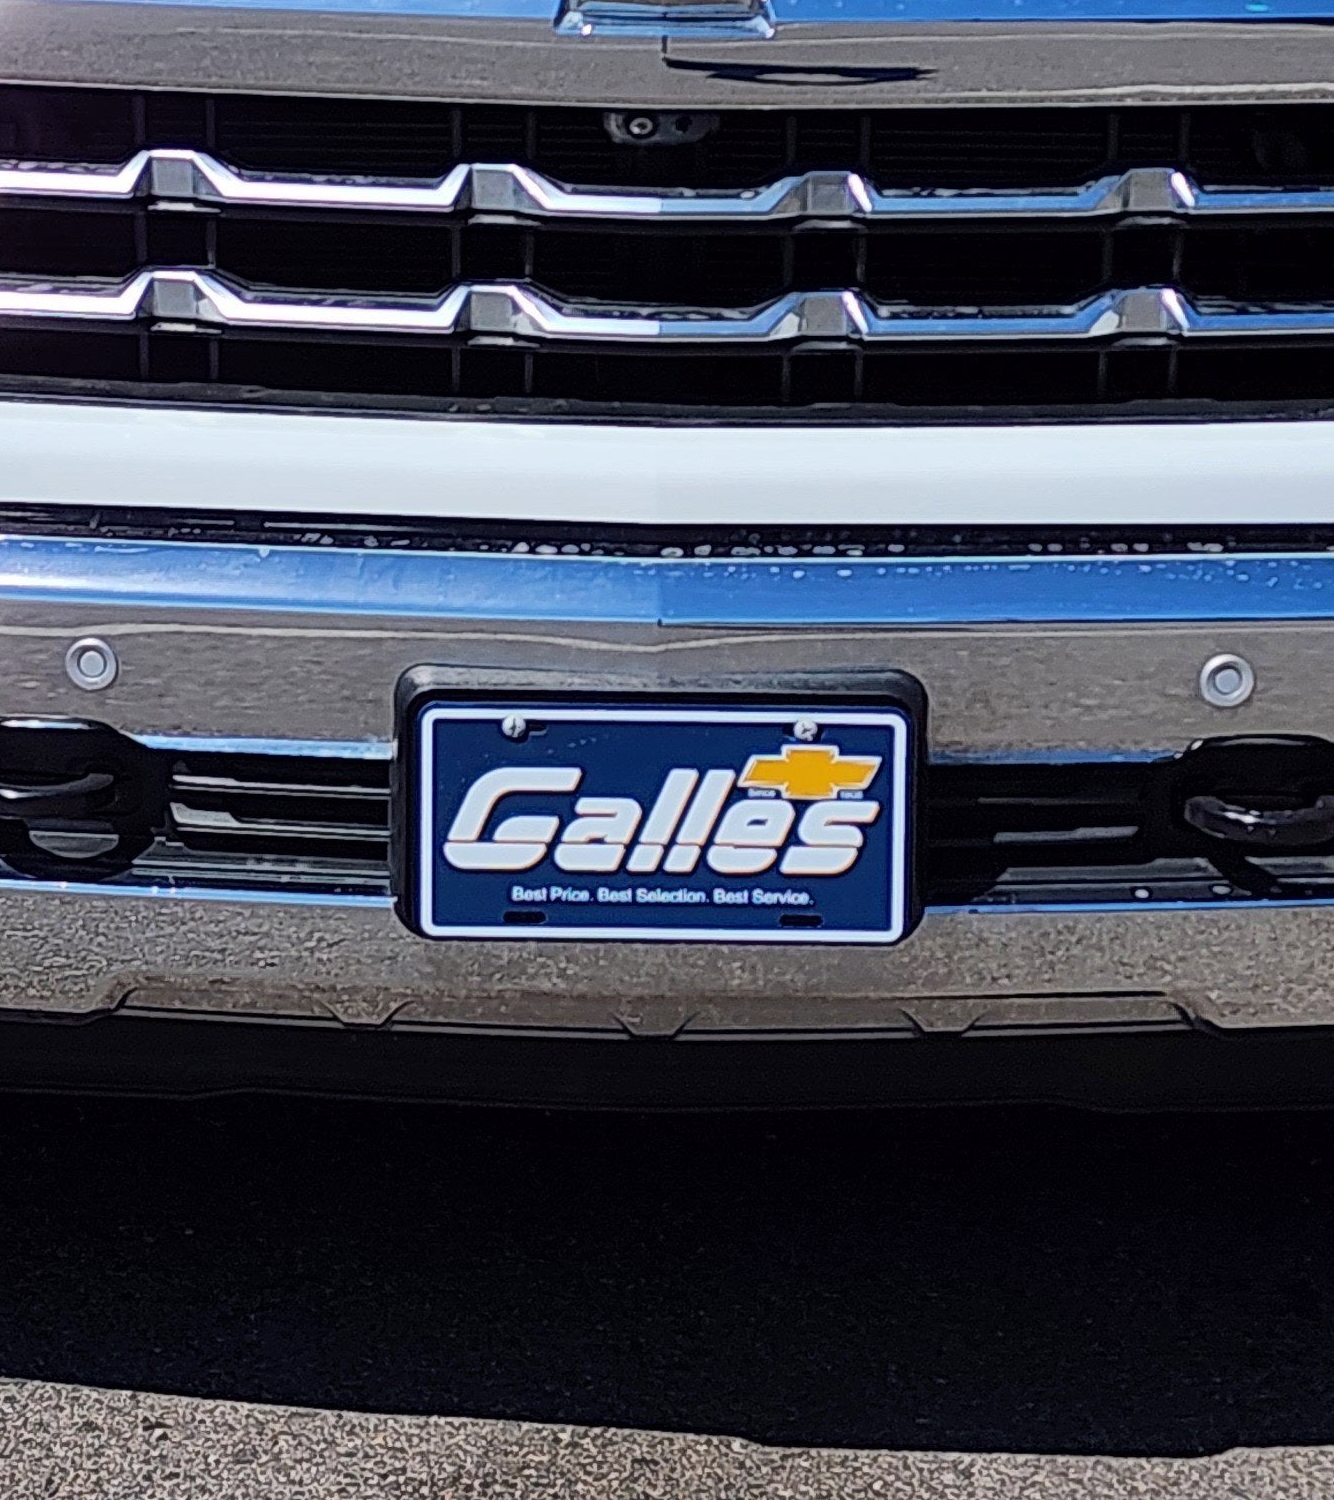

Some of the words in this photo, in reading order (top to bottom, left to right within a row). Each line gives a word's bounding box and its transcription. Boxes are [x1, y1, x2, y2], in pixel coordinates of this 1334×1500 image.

[443, 766, 881, 875] Galles
[512, 885, 548, 902] Best
[597, 887, 633, 903] Best
[713, 888, 749, 904] Best
